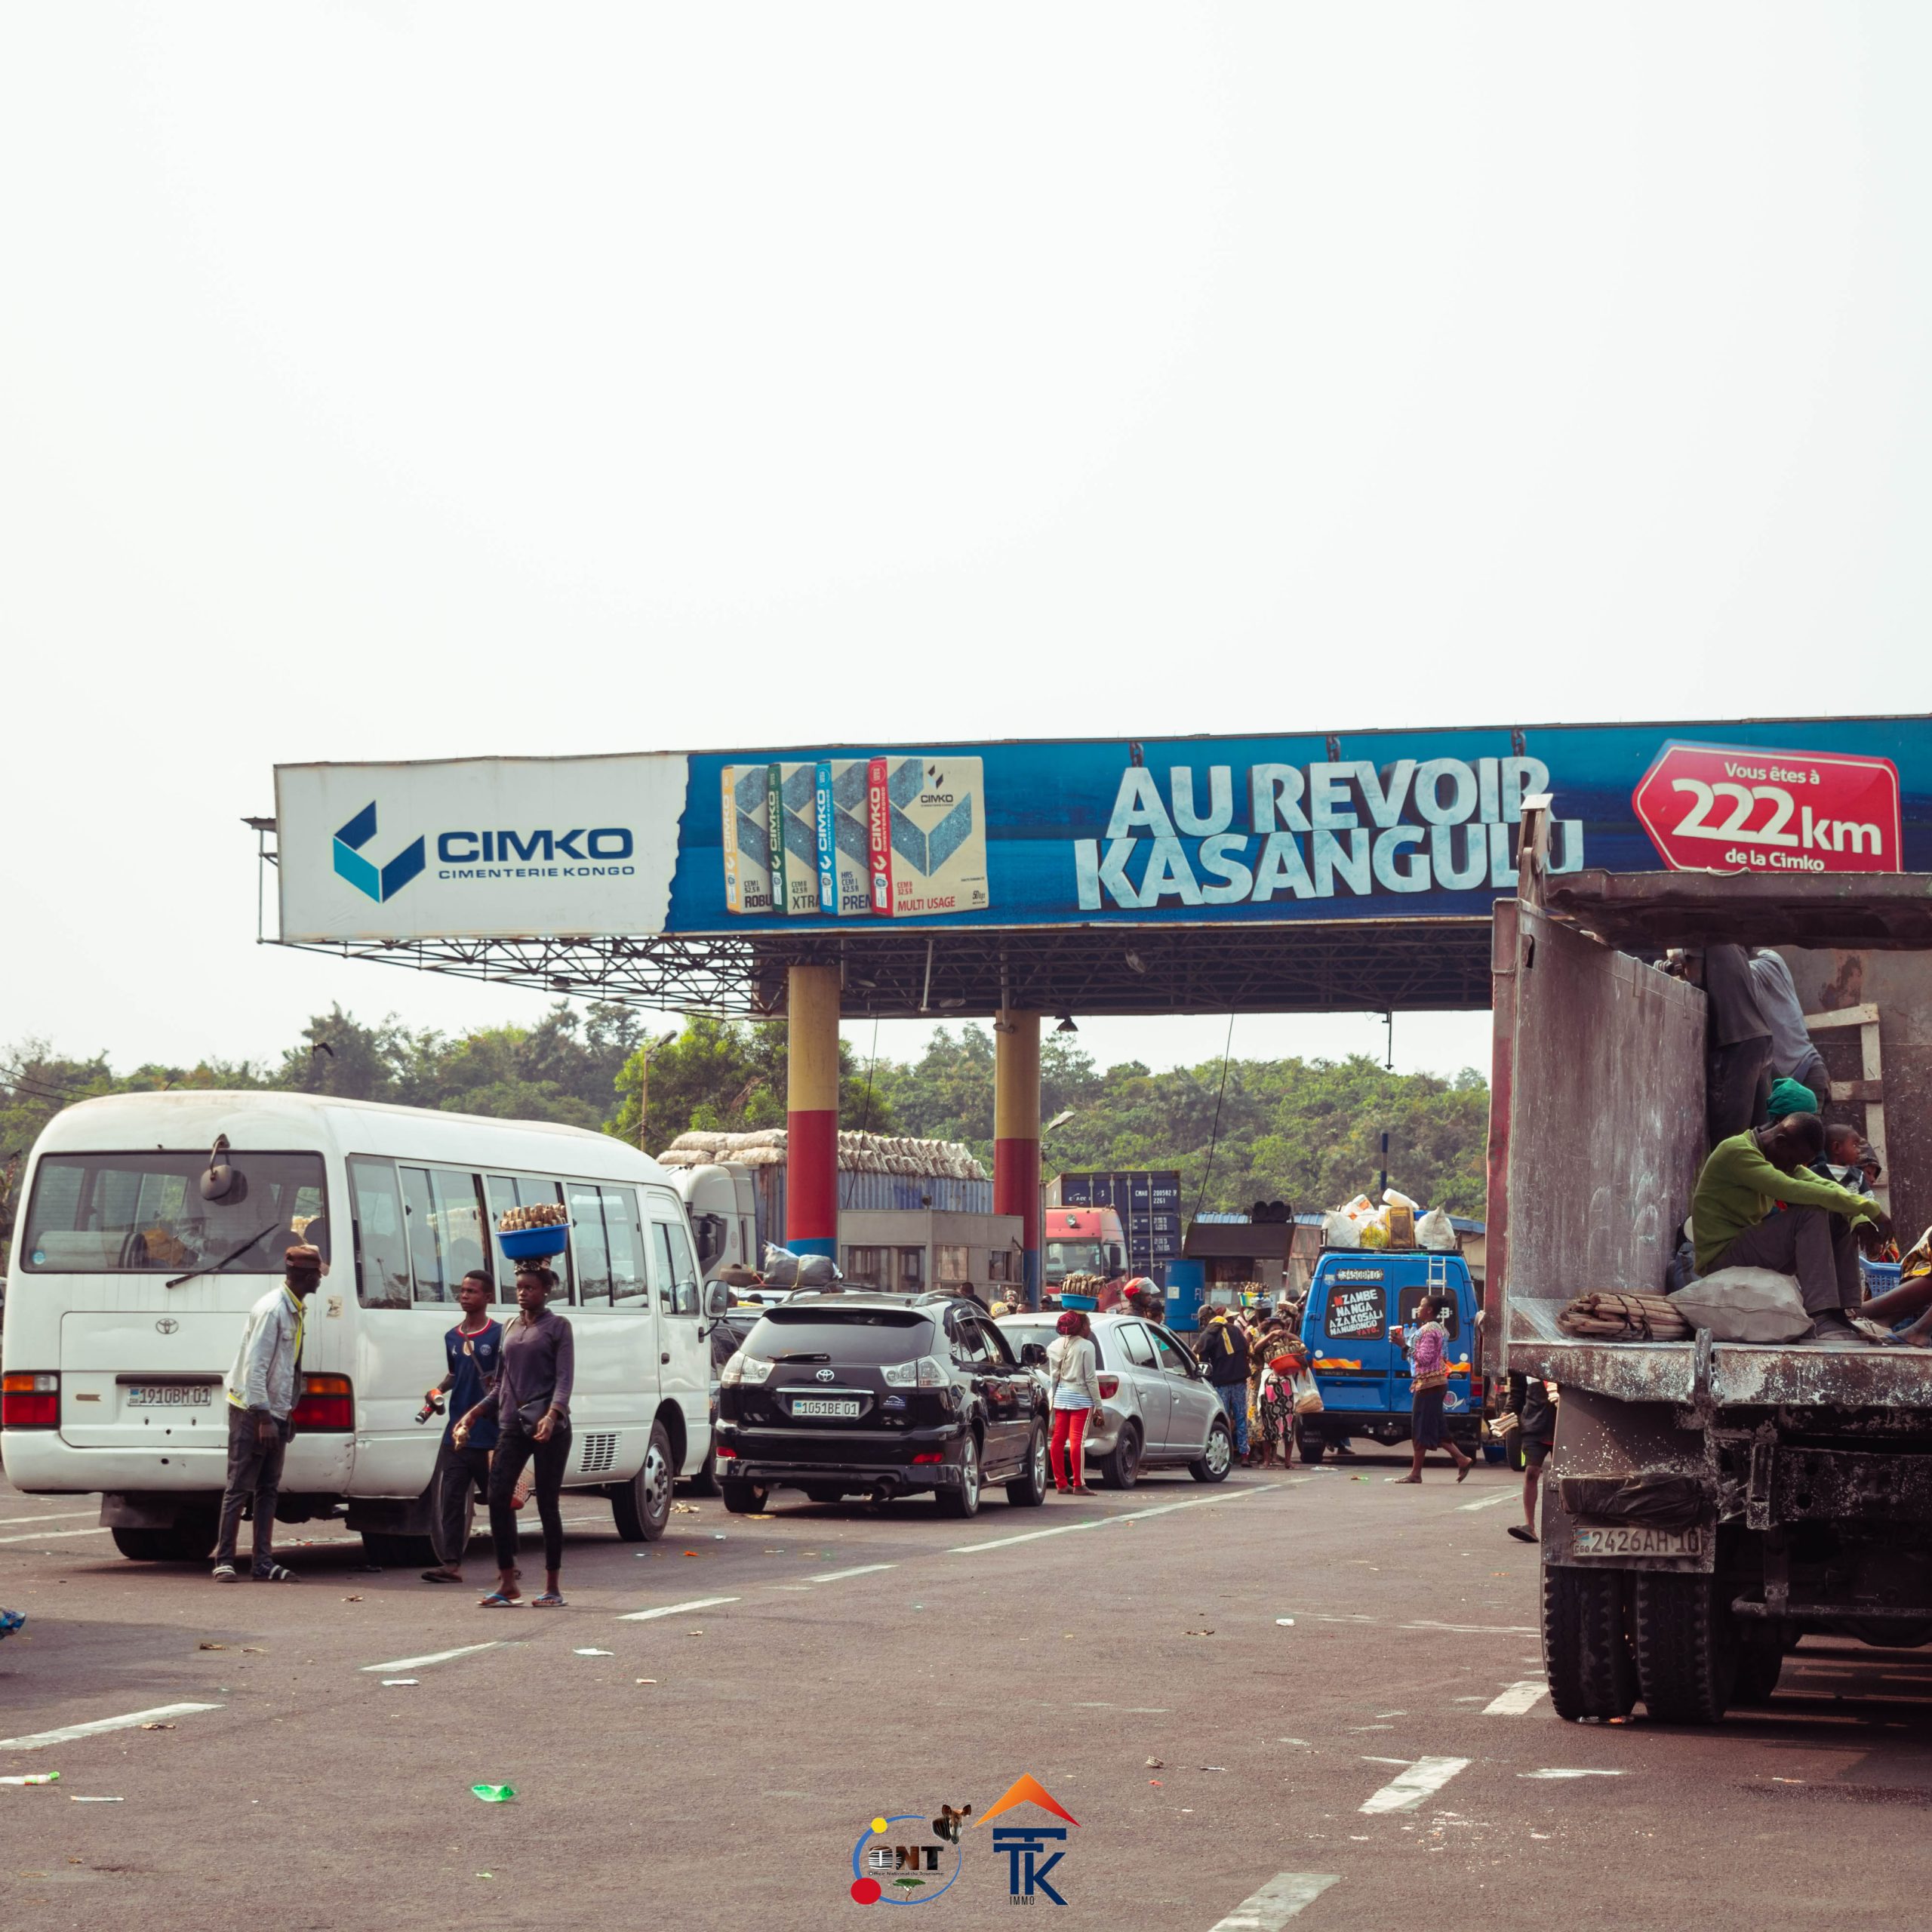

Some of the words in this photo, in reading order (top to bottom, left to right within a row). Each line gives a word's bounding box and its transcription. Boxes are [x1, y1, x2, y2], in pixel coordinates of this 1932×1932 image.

[1724, 761, 1766, 780] Vous
[1770, 765, 1803, 783] êtes
[1804, 768, 1820, 785] à
[921, 794, 953, 803] CIMKO
[1105, 765, 1233, 839] AU
[1251, 755, 1555, 833] REVOIR
[723, 795, 732, 853] CIMKO
[768, 791, 777, 851] CIMKO
[817, 789, 827, 851] CIMKO
[870, 787, 882, 851] CIMKO
[438, 828, 633, 863] CIMKO
[1724, 848, 1747, 865] de
[1750, 849, 1766, 866] la
[1769, 852, 1825, 872] Cimko
[438, 868, 559, 880] CIMENTERIE
[563, 866, 635, 877] KONGO
[897, 899, 924, 912] MULTI
[927, 896, 955, 909] USAGE
[140, 1388, 189, 1404] 1910BM
[193, 1388, 209, 1404] 01
[801, 1402, 841, 1415] 1051BE
[844, 1403, 857, 1415] 01
[1592, 1529, 1669, 1553] 2426AH
